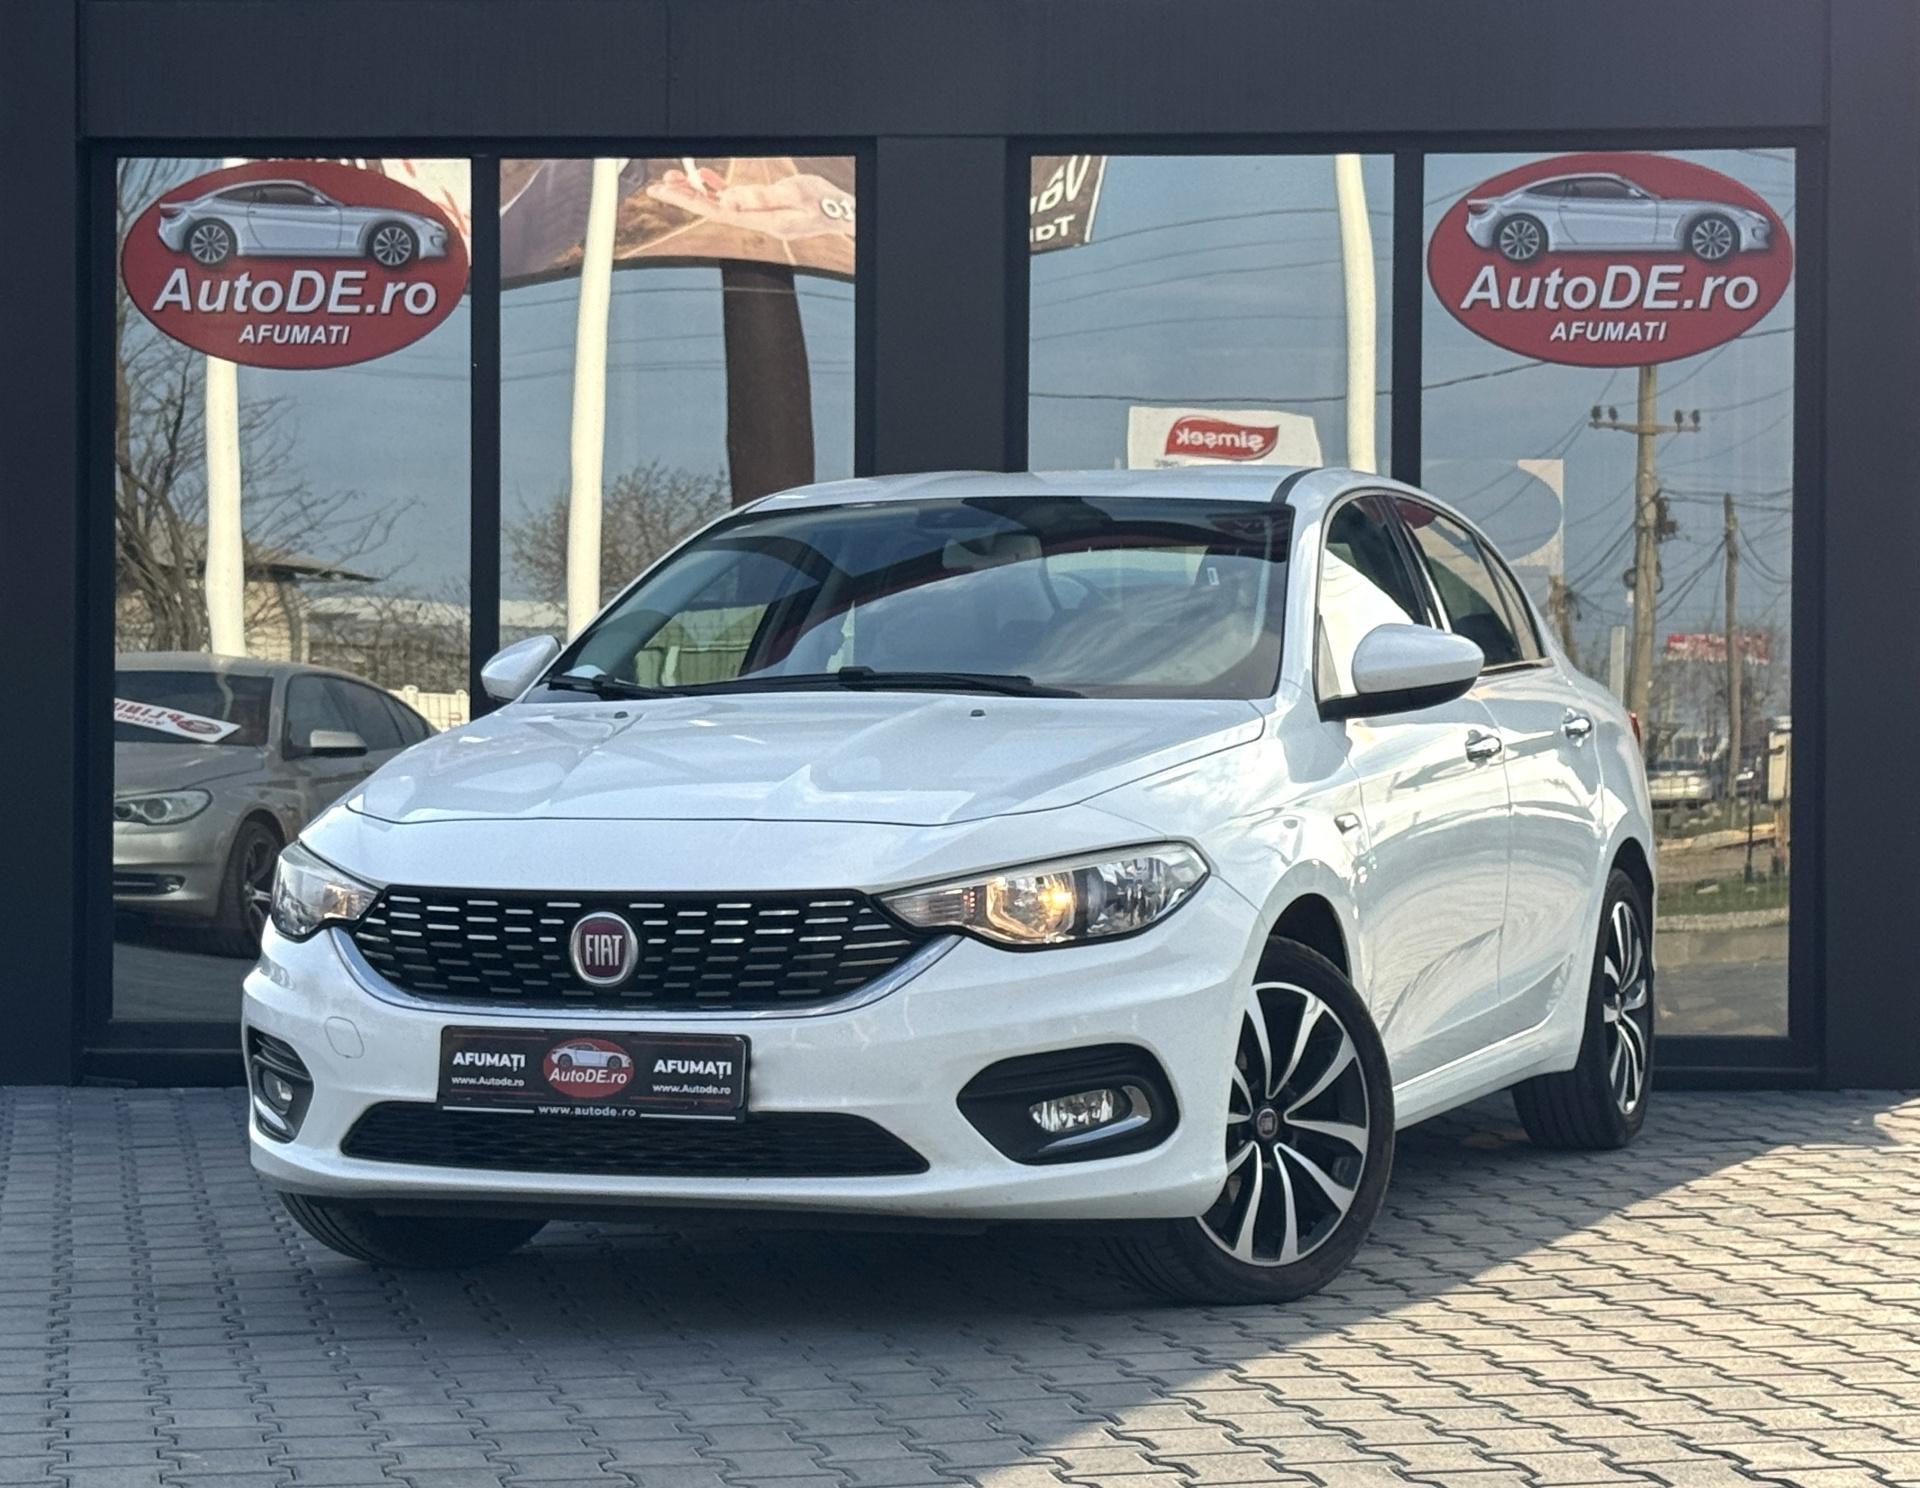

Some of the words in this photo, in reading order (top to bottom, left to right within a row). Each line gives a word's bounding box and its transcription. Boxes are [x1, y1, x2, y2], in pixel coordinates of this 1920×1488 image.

[153, 268, 438, 315] AutoDE.ro
[1460, 265, 1758, 310] AutoDE.ro
[238, 324, 351, 345] AFUMATI
[1549, 322, 1667, 342] AFUMATI
[585, 934, 623, 967] FIAT
[452, 1052, 526, 1072] AFUMAȚI
[653, 1059, 732, 1079] AFUMAȚI
[451, 1076, 525, 1087] www.Autode.ro
[548, 1067, 628, 1084] AutoDE.ro
[652, 1084, 732, 1095] www.Autode.ro
[537, 1106, 637, 1116] www.autode.ro
